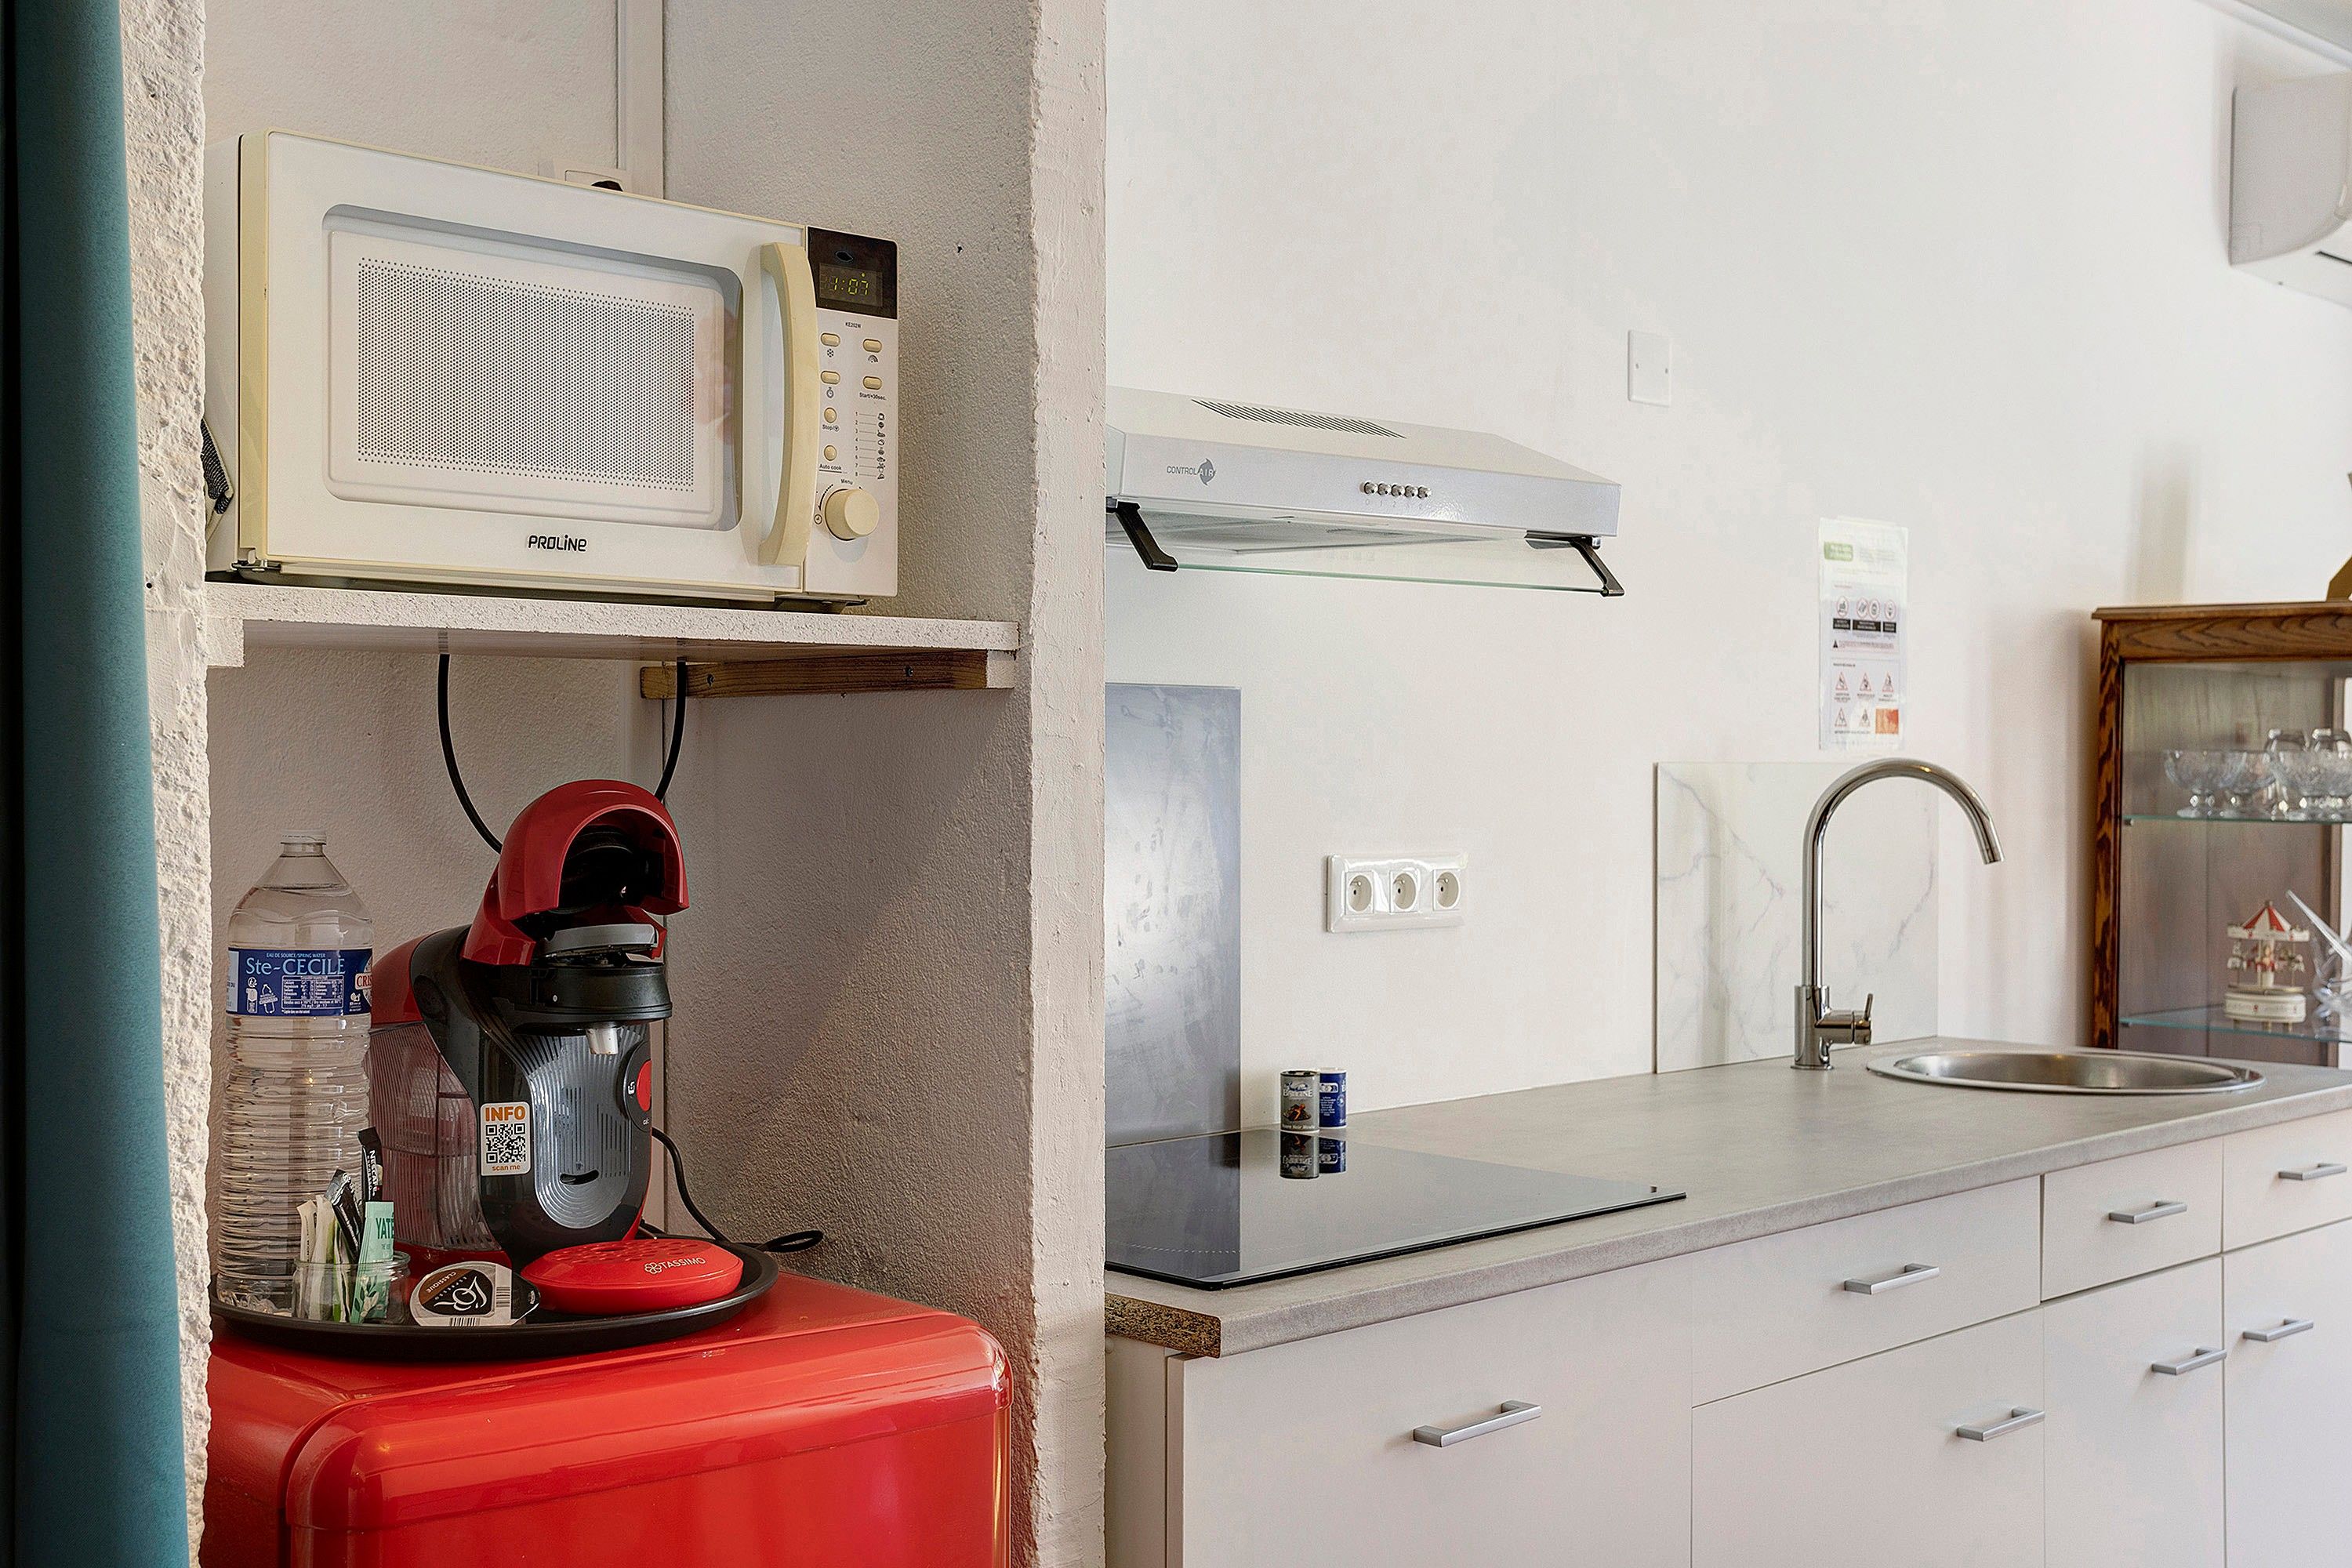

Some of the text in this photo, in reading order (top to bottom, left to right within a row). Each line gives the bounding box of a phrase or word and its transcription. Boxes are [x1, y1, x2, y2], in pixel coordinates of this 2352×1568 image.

[834, 278, 869, 296] 1:07
[1167, 466, 1197, 475] CONTROL
[246, 957, 345, 975] Ste-CECILE
[485, 1105, 525, 1121] INFO
[659, 1258, 706, 1269] TASSIMO
[426, 1271, 457, 1294] CLASSIQUE
